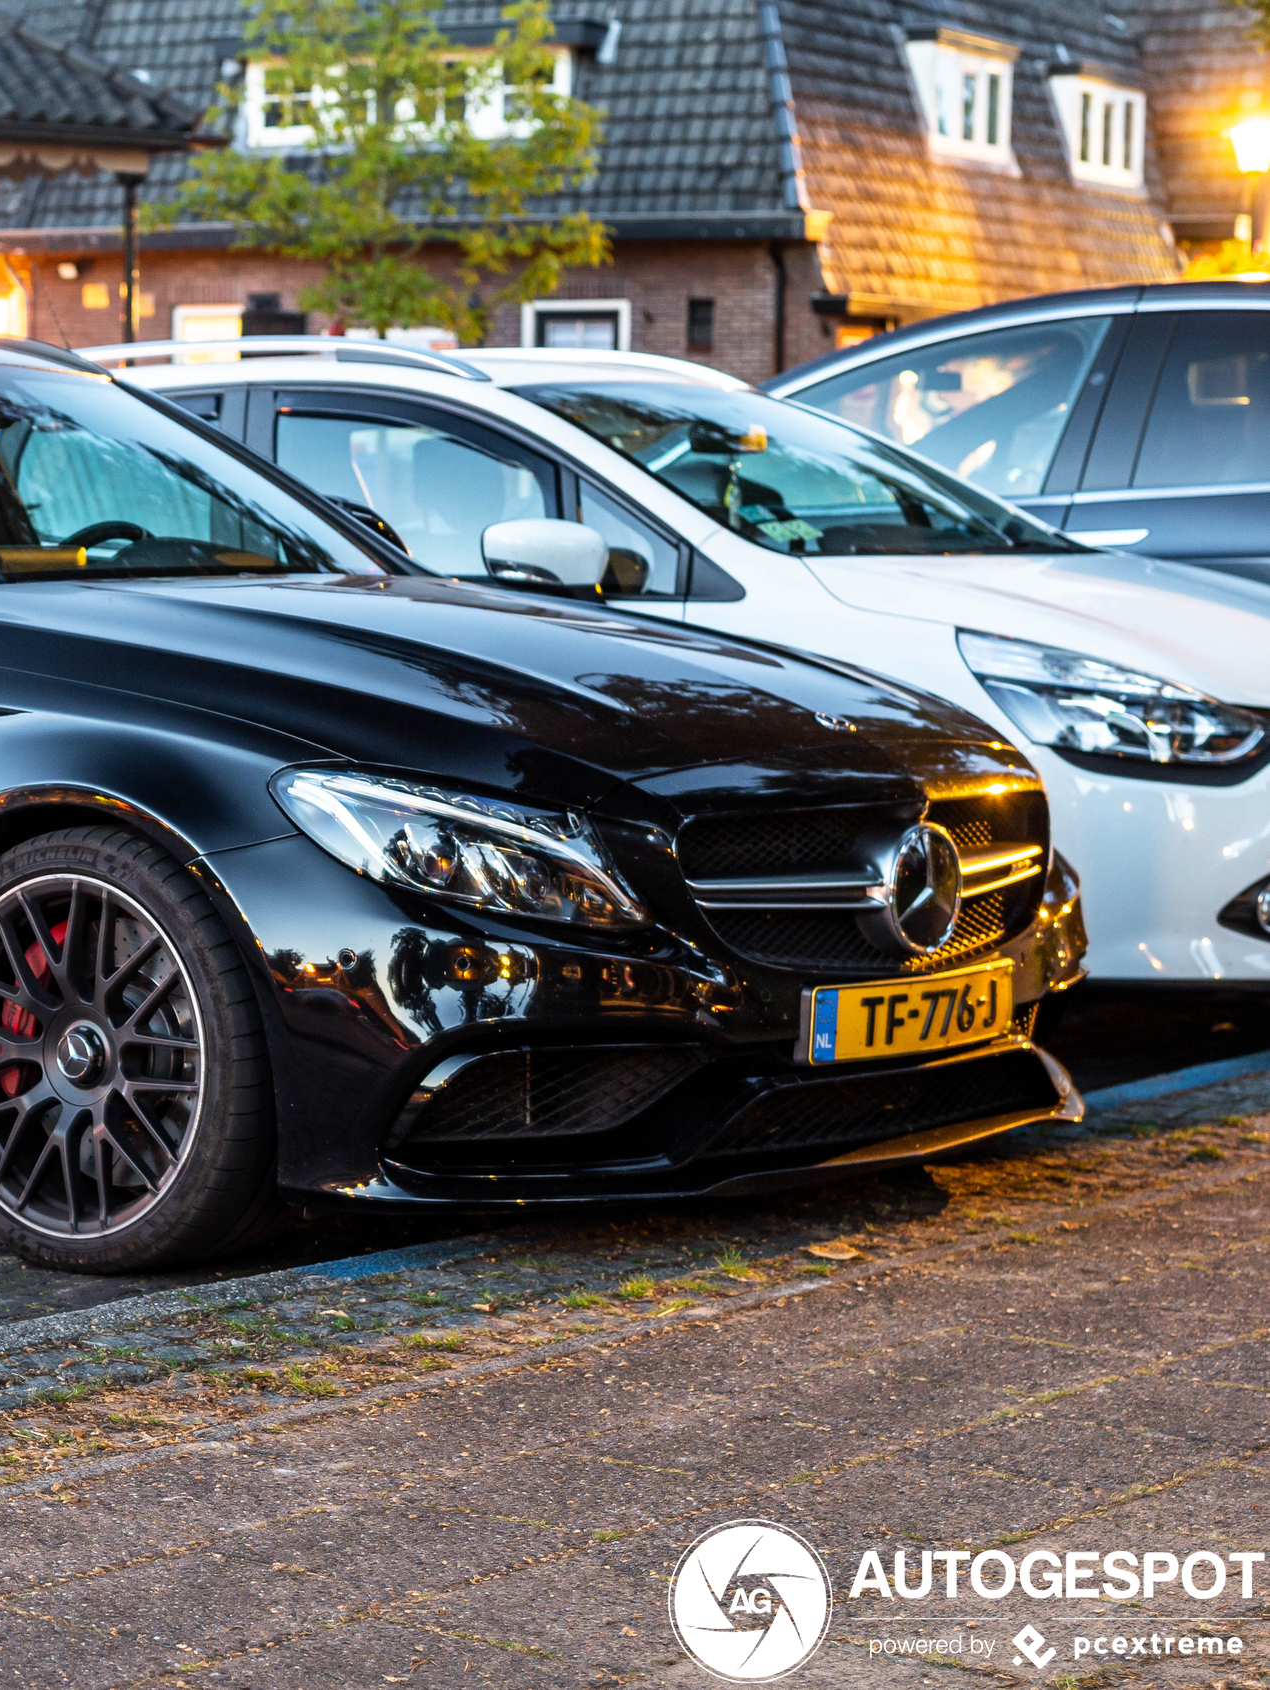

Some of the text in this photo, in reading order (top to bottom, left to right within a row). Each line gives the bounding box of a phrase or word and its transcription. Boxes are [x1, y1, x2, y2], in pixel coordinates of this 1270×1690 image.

[15, 847, 96, 869] MICHELIN
[860, 979, 998, 1047] TF-776-J
[815, 1033, 832, 1049] NL
